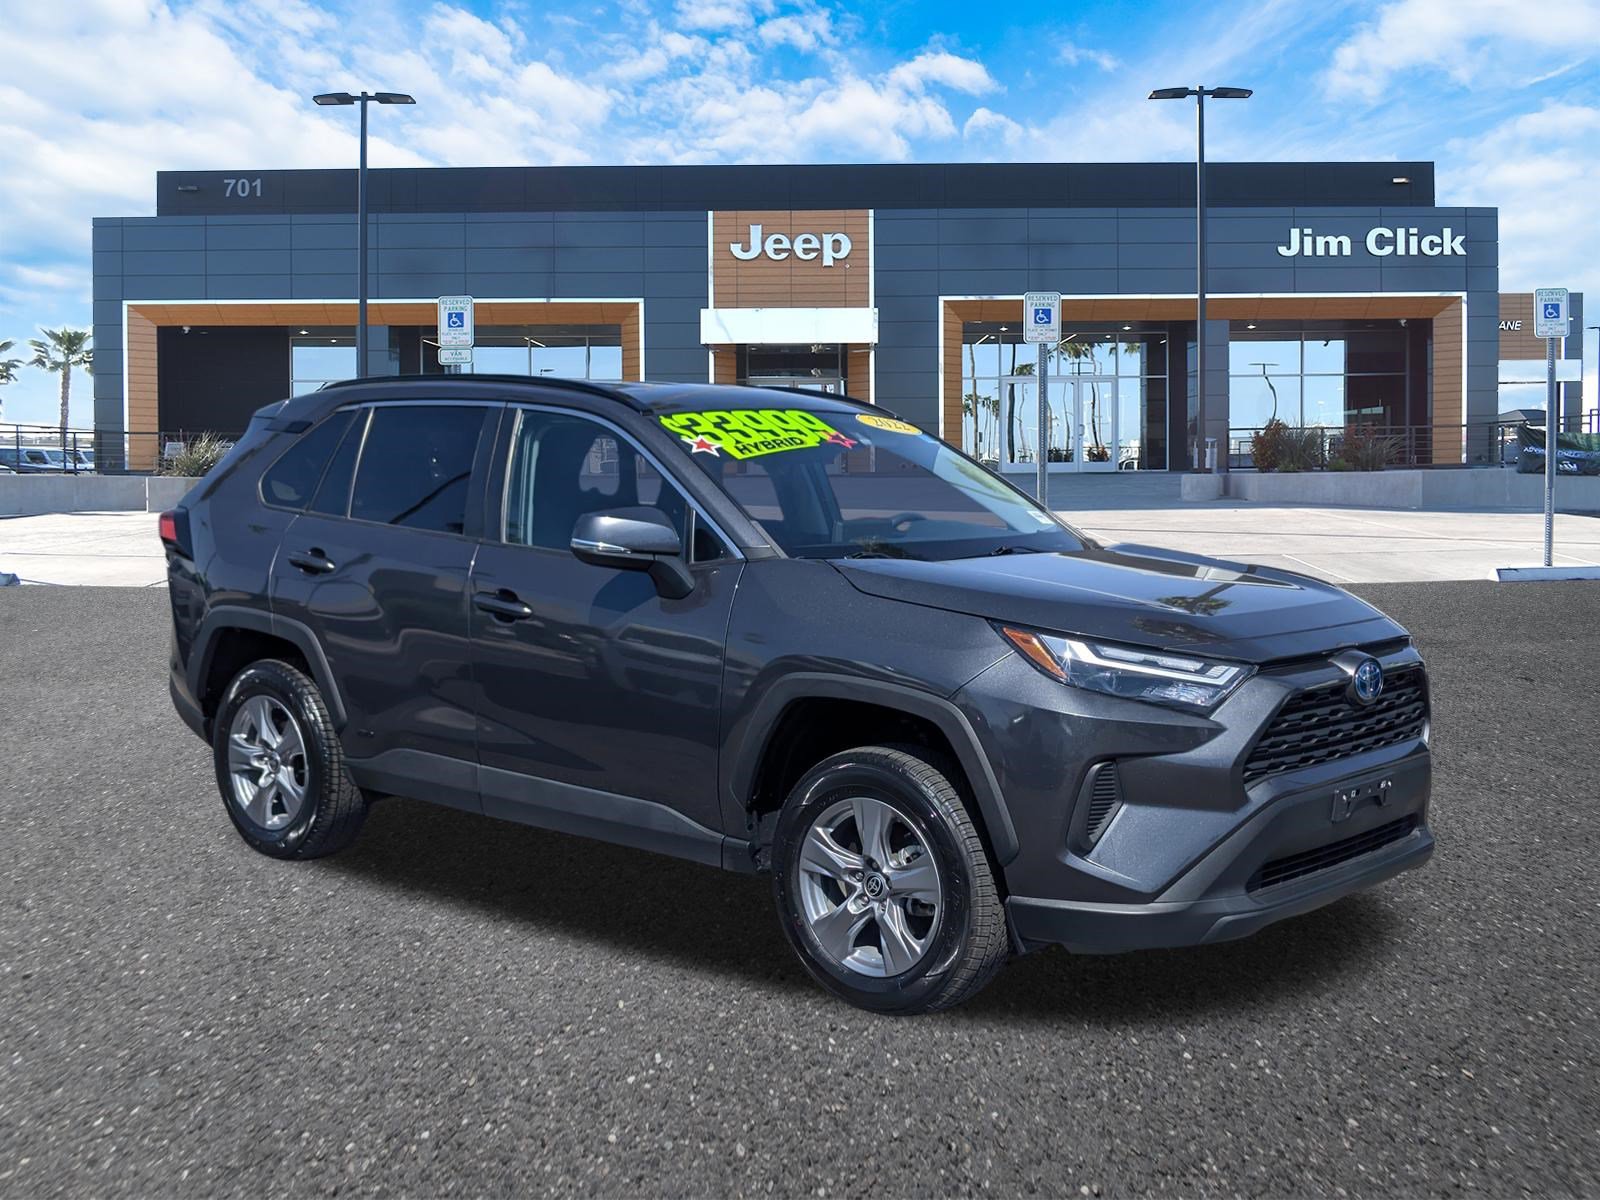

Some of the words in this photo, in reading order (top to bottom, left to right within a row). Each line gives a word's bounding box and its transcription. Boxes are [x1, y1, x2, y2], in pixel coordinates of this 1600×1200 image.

[223, 178, 262, 197] 701
[730, 224, 852, 267] Jeep
[1277, 228, 1351, 257] Jim
[1366, 227, 1467, 257] Click
[1498, 320, 1522, 331] ANE
[735, 437, 805, 455] HYBRID
